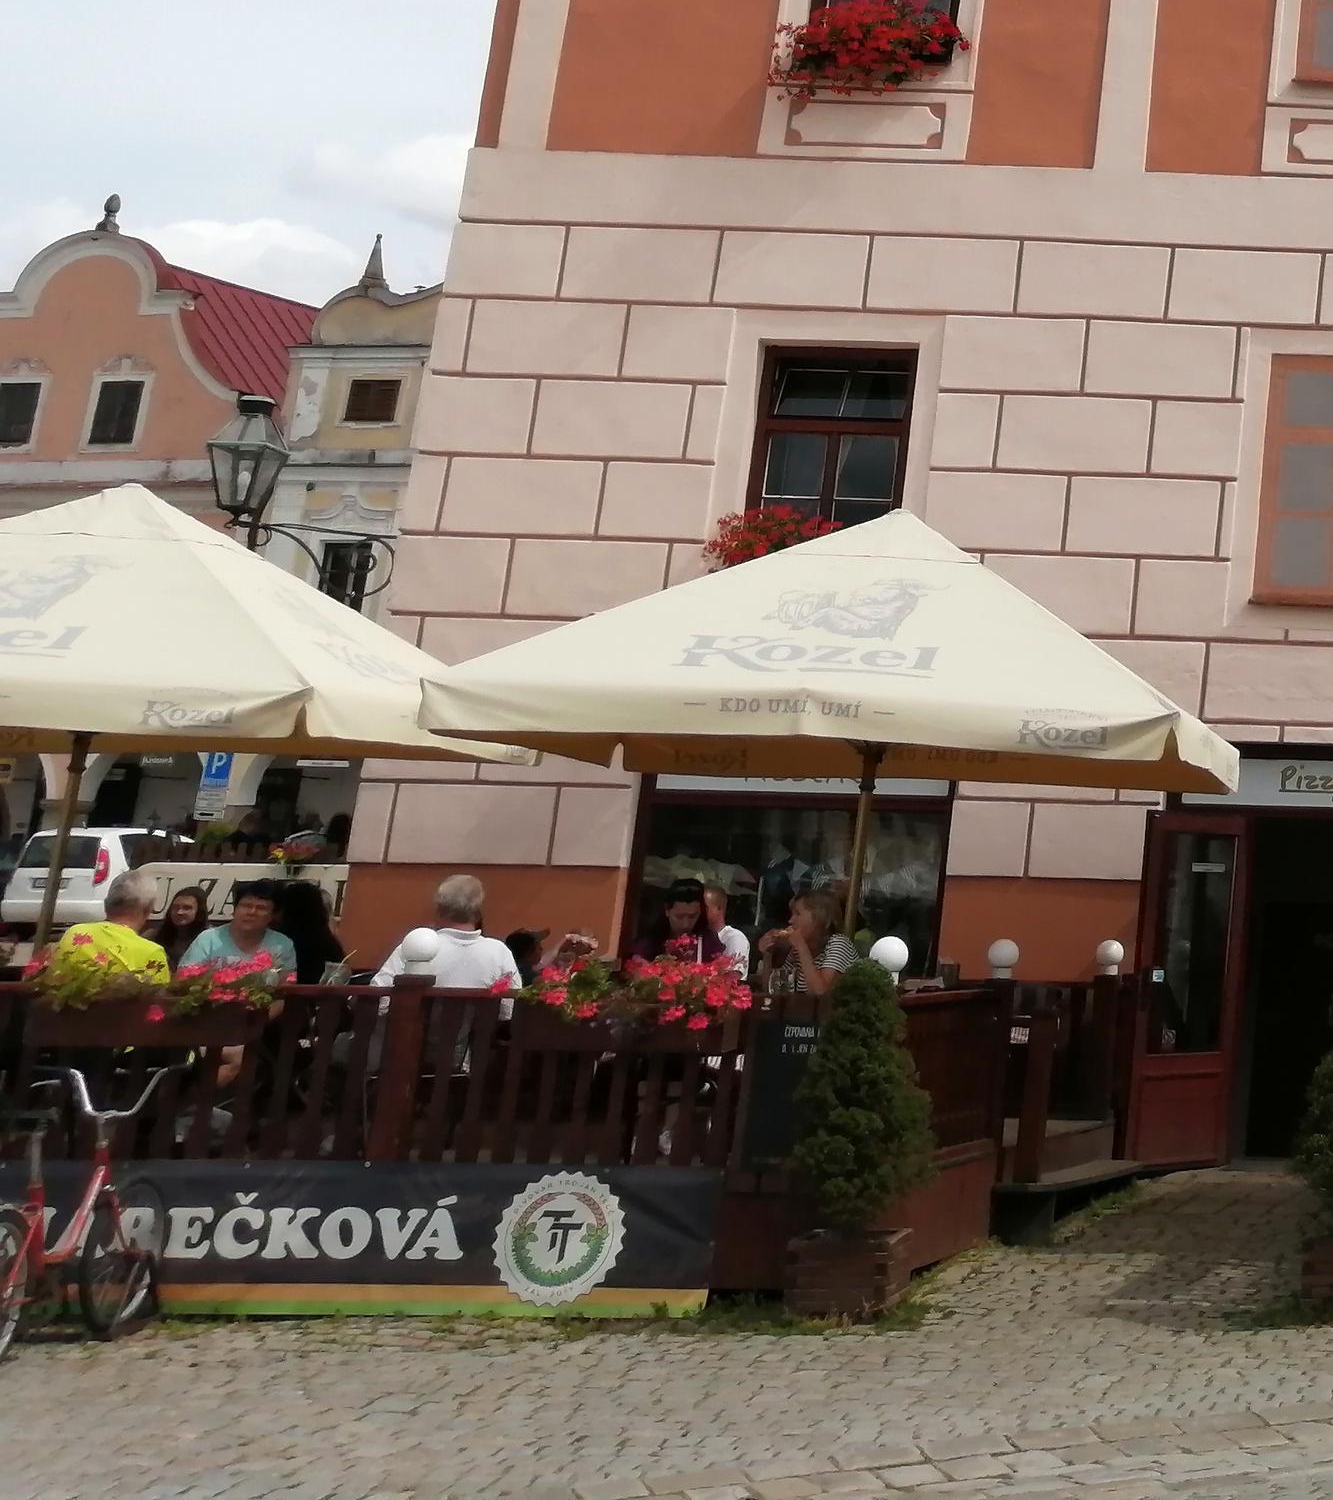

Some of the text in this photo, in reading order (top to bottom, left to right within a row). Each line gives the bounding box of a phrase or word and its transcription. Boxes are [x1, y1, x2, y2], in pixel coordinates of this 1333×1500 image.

[672, 634, 941, 676] Kozel
[138, 700, 238, 729] Kozel
[719, 697, 760, 713] KDO
[820, 701, 862, 719] UMÍ
[1016, 718, 1110, 749] Kozel
[210, 752, 227, 775] P
